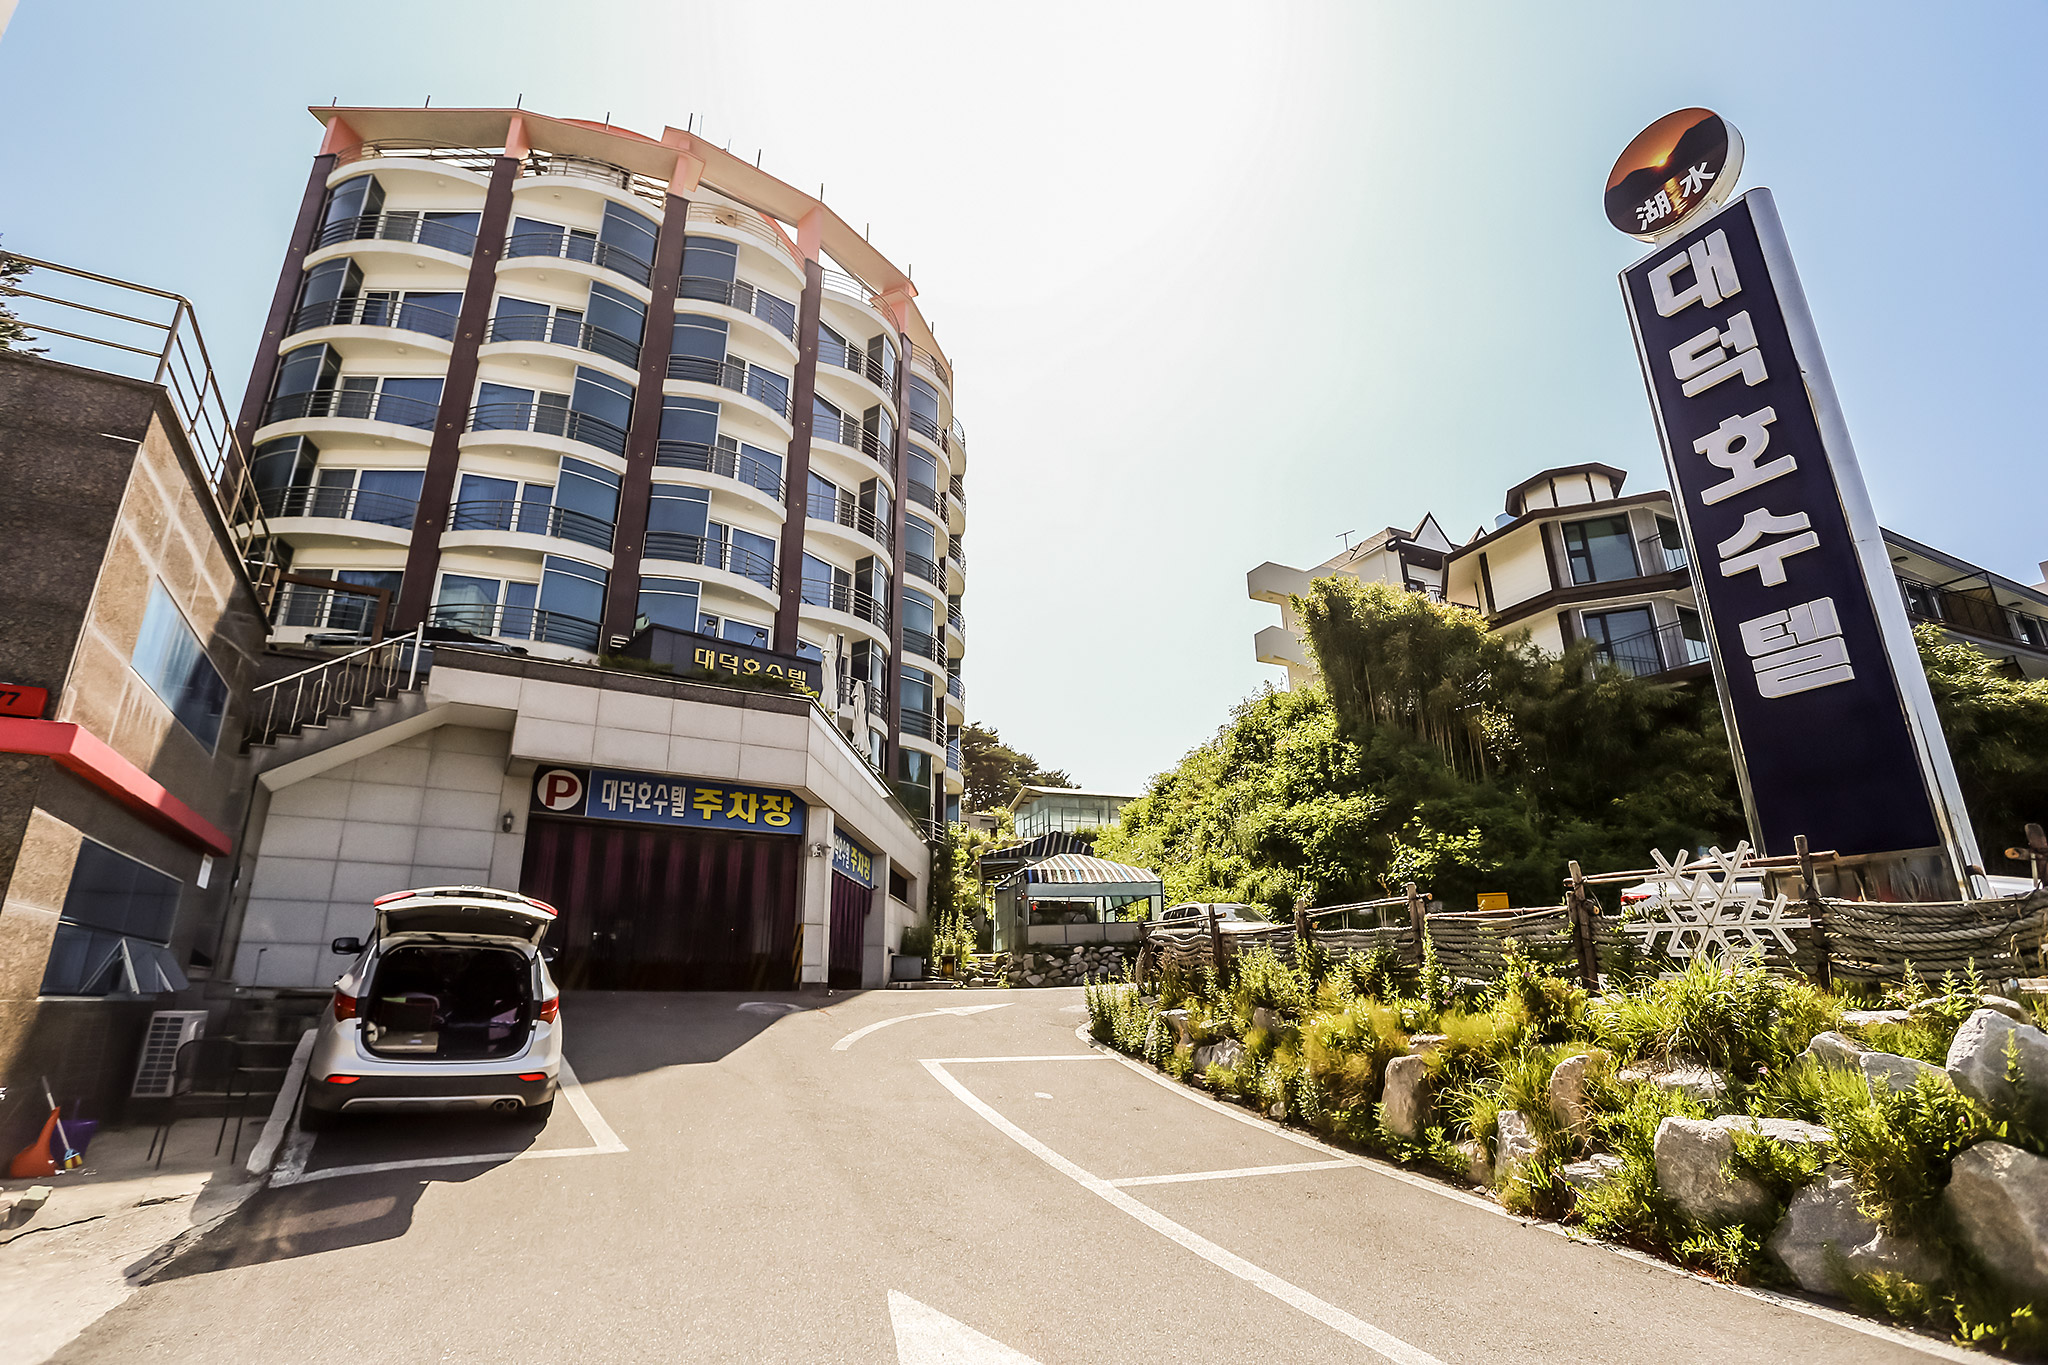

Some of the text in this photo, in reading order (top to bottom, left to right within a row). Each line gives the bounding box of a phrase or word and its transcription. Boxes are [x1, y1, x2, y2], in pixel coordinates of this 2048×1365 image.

[1635, 162, 1716, 231] 湖水
[1647, 228, 1856, 699] 대덕호수텔
[545, 774, 578, 807] P
[601, 779, 794, 827] 대덕호수텔 주차장
[850, 846, 871, 881] 주차장
